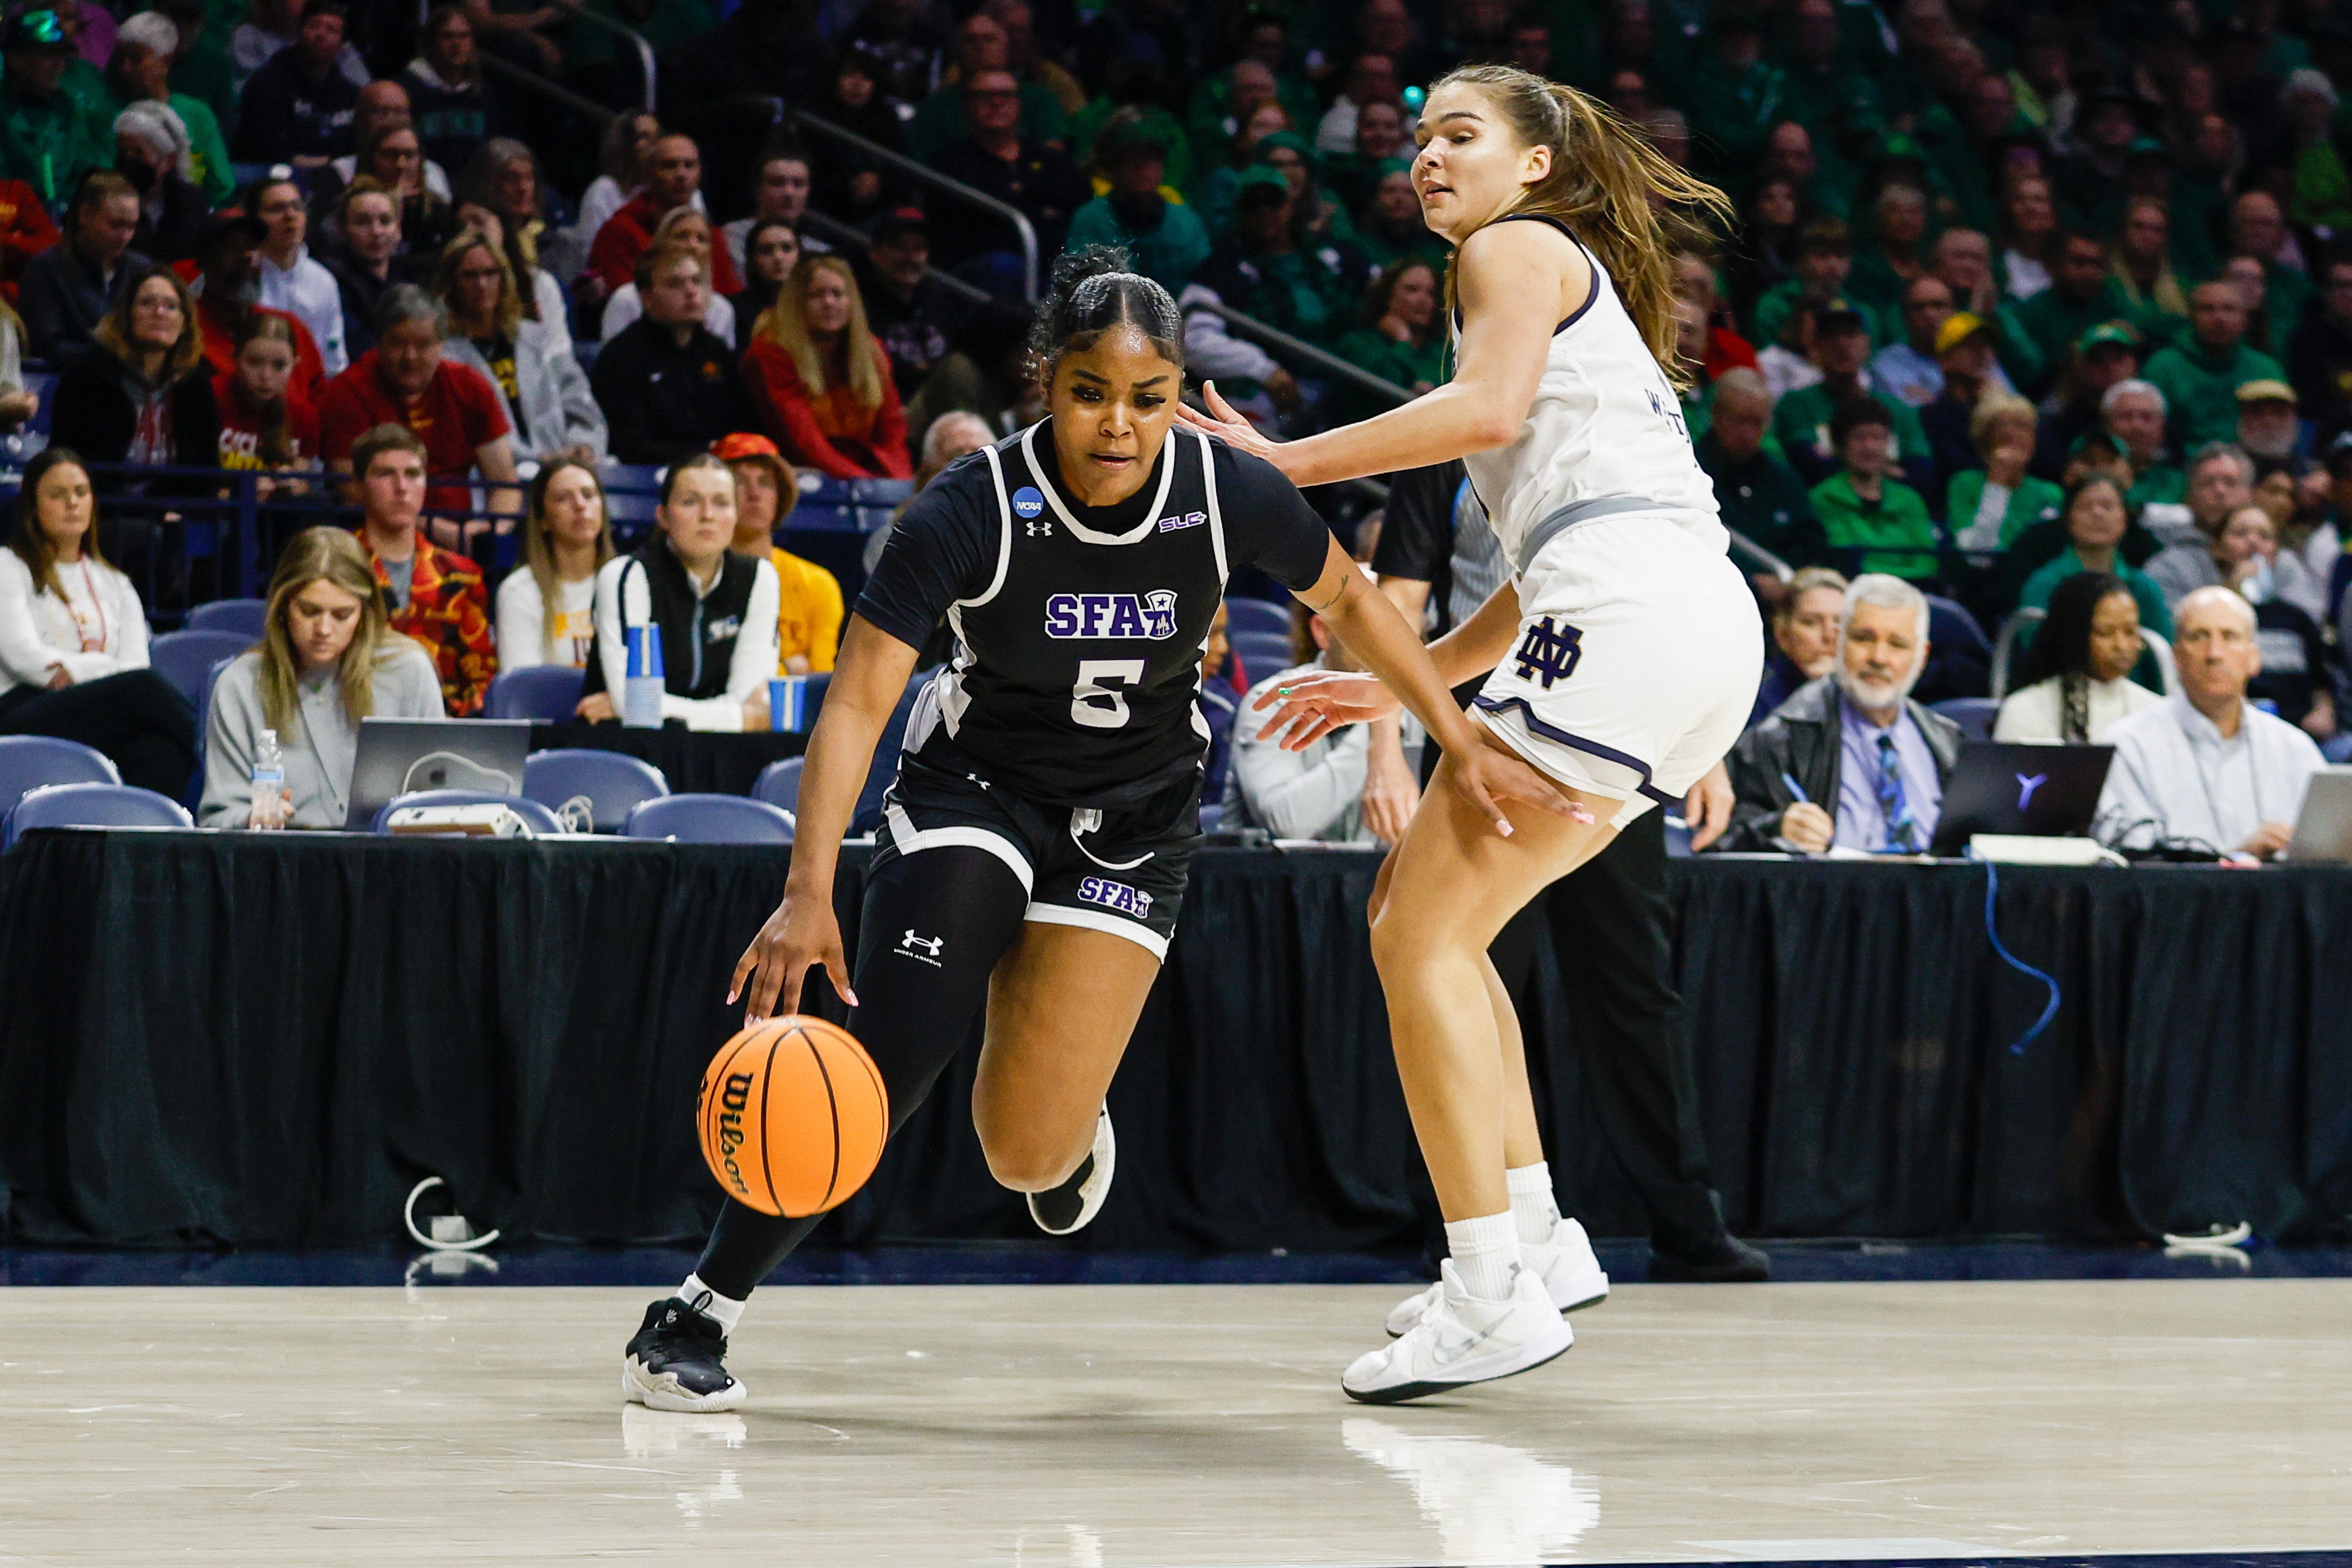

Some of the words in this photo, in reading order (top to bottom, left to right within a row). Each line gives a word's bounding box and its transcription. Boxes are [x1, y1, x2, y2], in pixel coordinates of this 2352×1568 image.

[1016, 501, 1042, 511] NCAA
[1160, 512, 1203, 532] SLC
[1045, 594, 1146, 638] SFA
[1071, 660, 1145, 728] 5
[1078, 877, 1135, 913] SFA
[894, 948, 914, 958] UNDER
[914, 954, 942, 968] ARMOUR
[720, 1072, 754, 1195] Wilson
